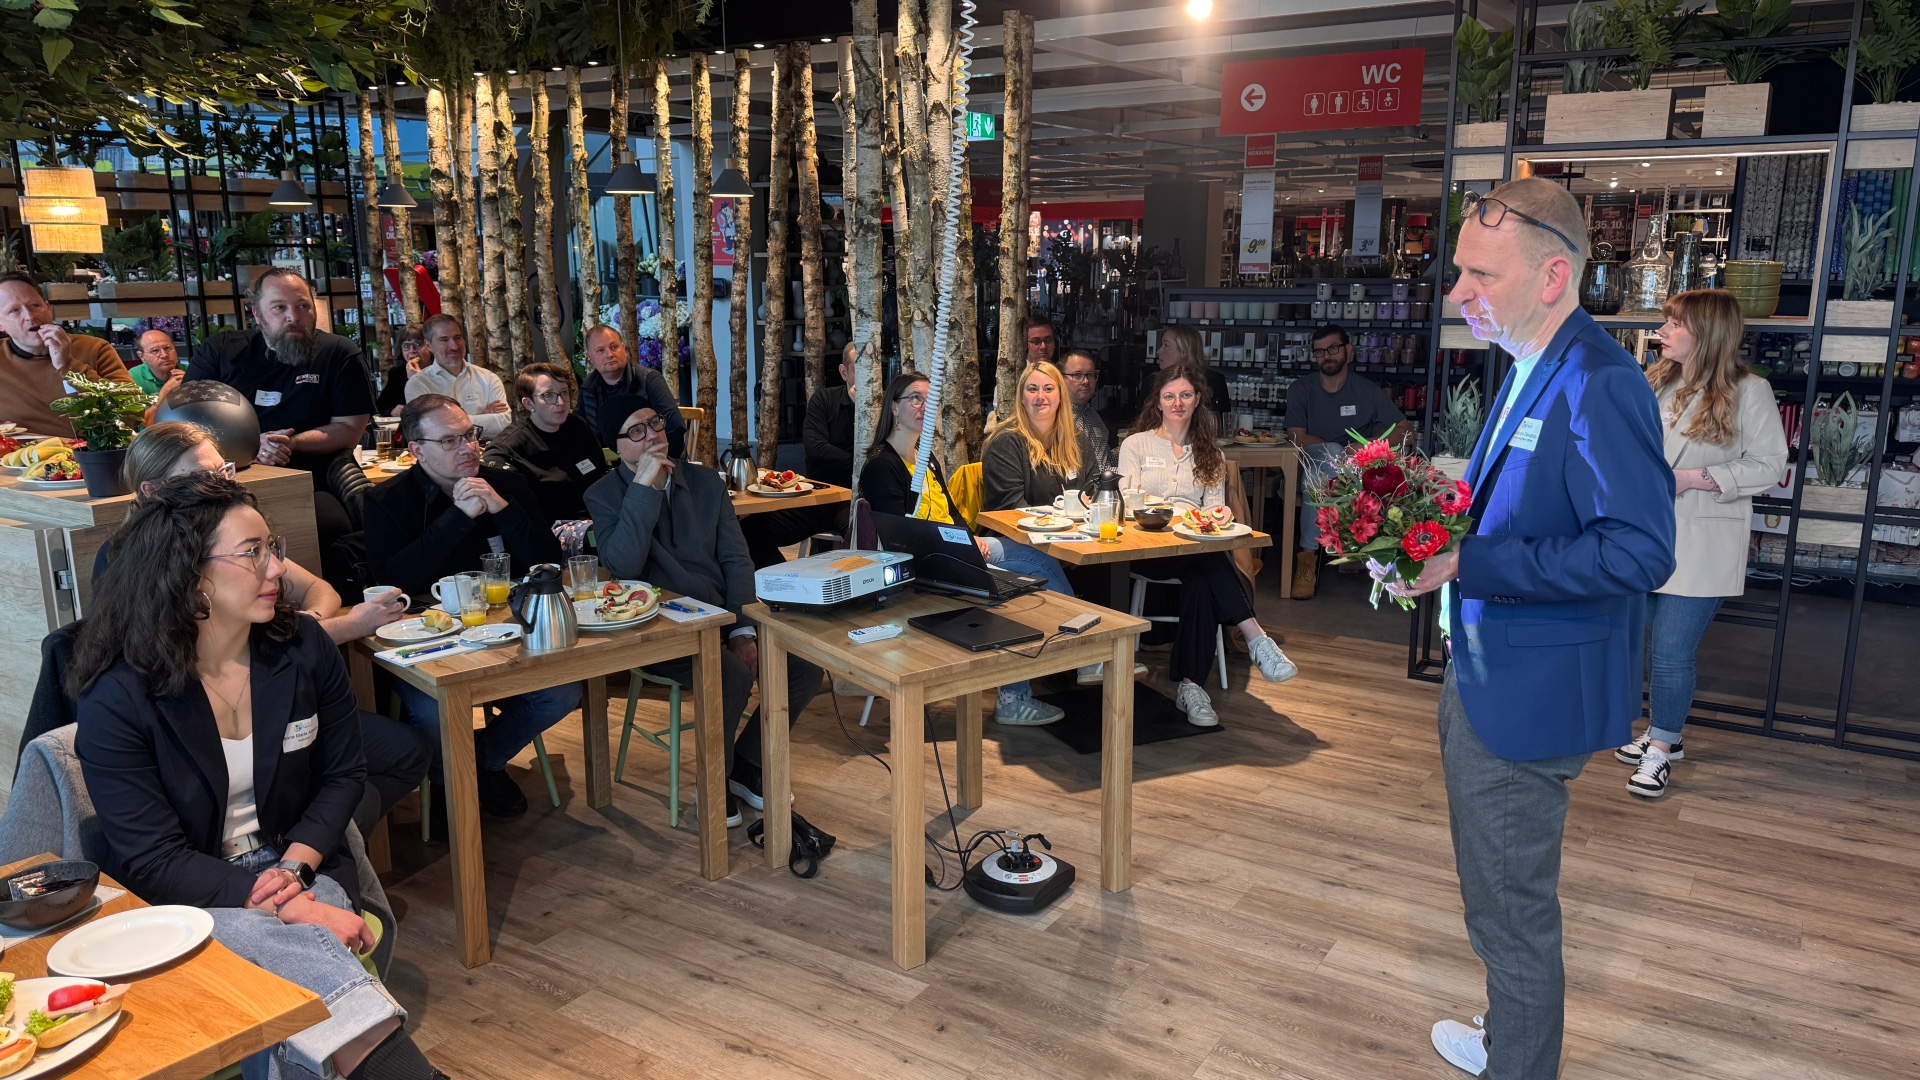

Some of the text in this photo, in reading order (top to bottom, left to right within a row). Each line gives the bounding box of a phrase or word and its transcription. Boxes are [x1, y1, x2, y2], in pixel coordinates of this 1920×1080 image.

[1361, 63, 1401, 84] WC
[1360, 167, 1382, 175] PREIS
[863, 577, 875, 585] EPSON
